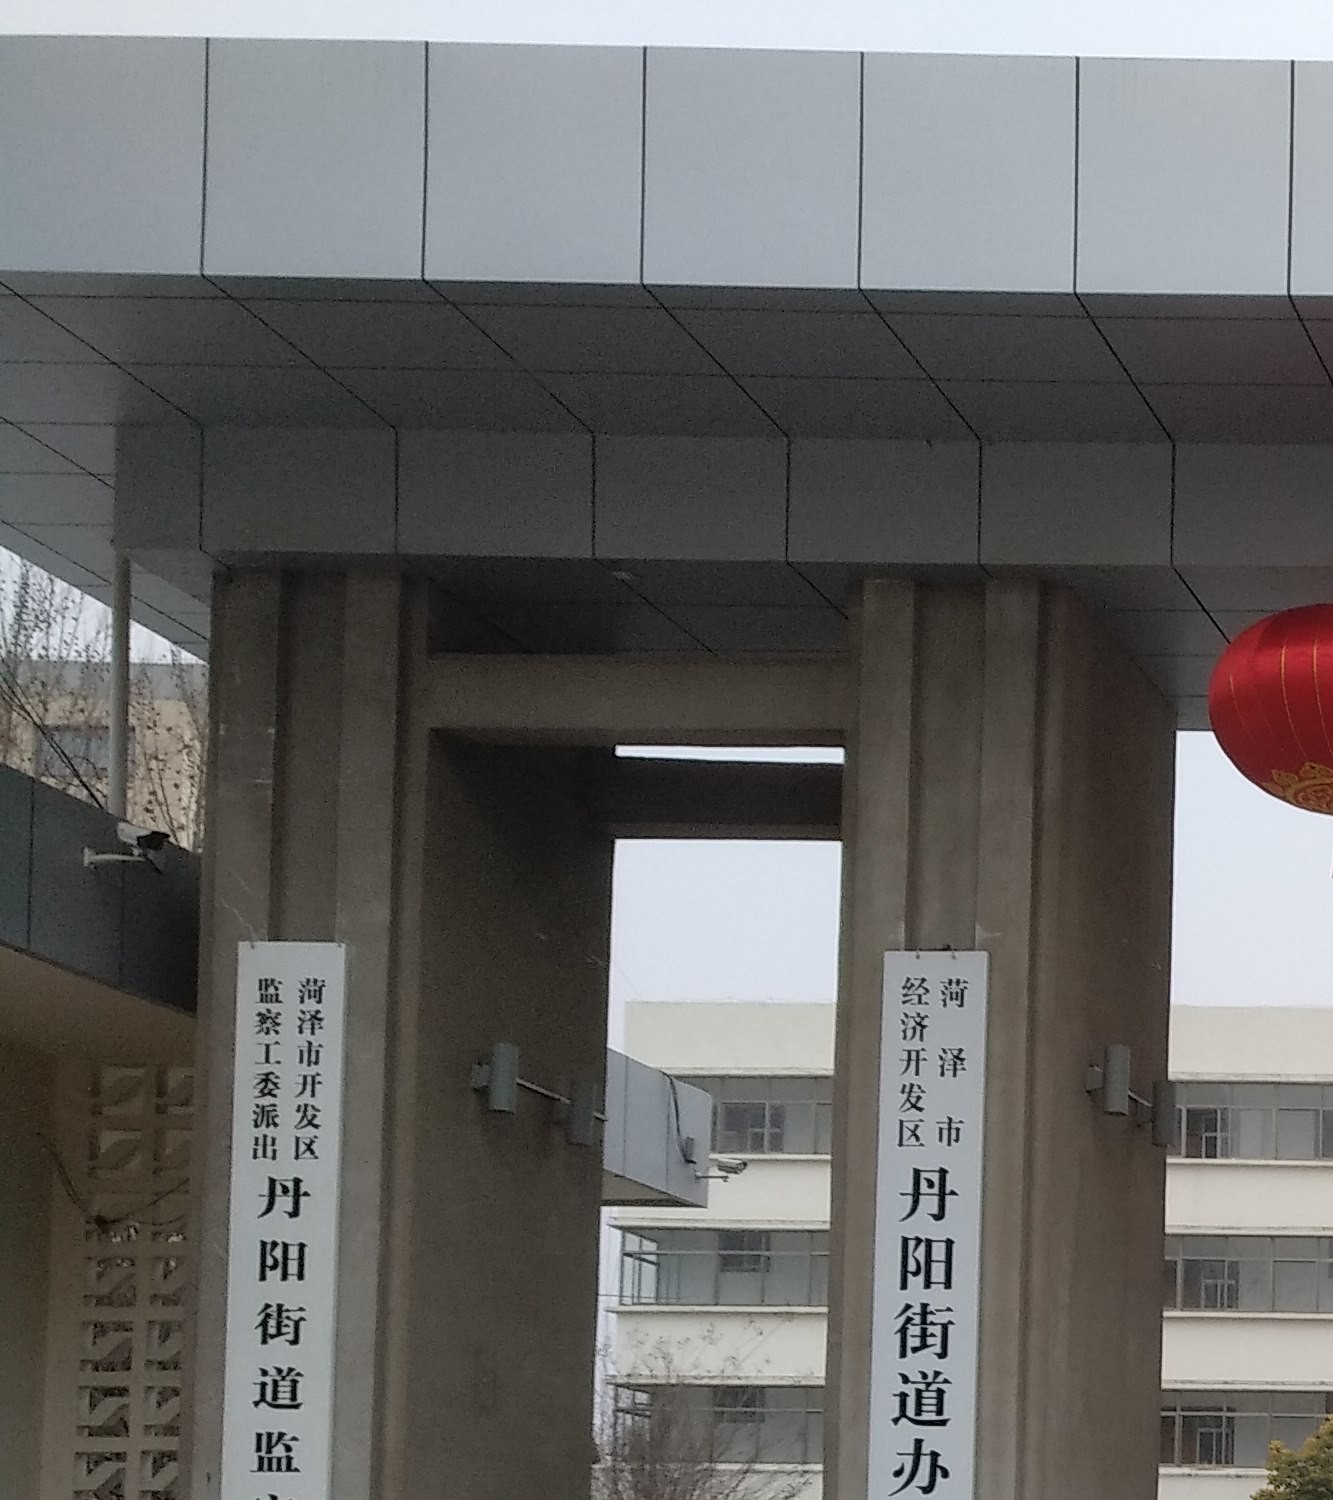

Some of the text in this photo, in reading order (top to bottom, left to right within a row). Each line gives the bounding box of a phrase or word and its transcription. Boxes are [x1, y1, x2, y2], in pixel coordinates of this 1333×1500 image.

[251, 977, 284, 1162] 监察工委派出
[293, 977, 327, 1162] 菏泽市开发区
[897, 976, 931, 1149] 经济开发区
[934, 978, 969, 1148] 菏泽市
